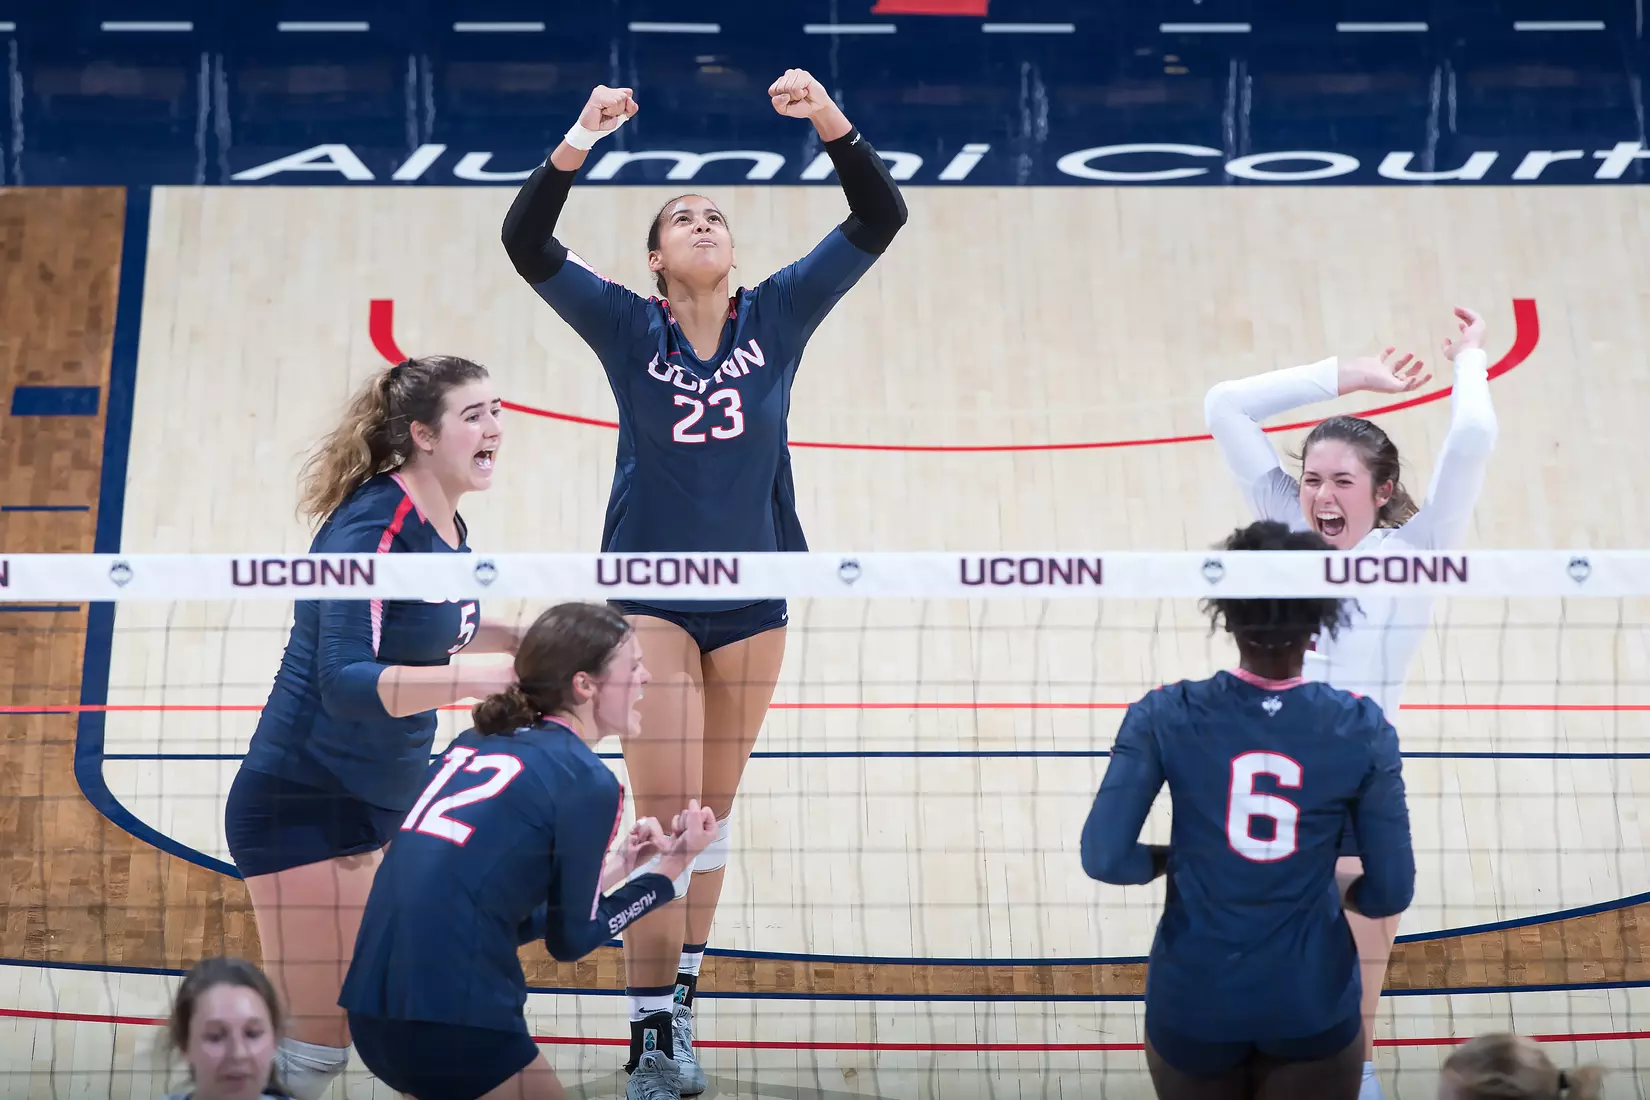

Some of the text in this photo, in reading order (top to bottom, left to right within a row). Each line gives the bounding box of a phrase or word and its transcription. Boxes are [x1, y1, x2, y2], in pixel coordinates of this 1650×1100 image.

[230, 141, 1650, 181] Alumni Court
[672, 387, 745, 443] 23
[231, 558, 375, 587] UCONN
[596, 557, 739, 587] UCONN
[960, 556, 1103, 586] UCONN
[1324, 555, 1468, 585] UCONN
[446, 601, 476, 655] 5
[399, 745, 526, 847] 12
[1225, 749, 1304, 863] 6
[607, 889, 657, 935] HUSKIES
